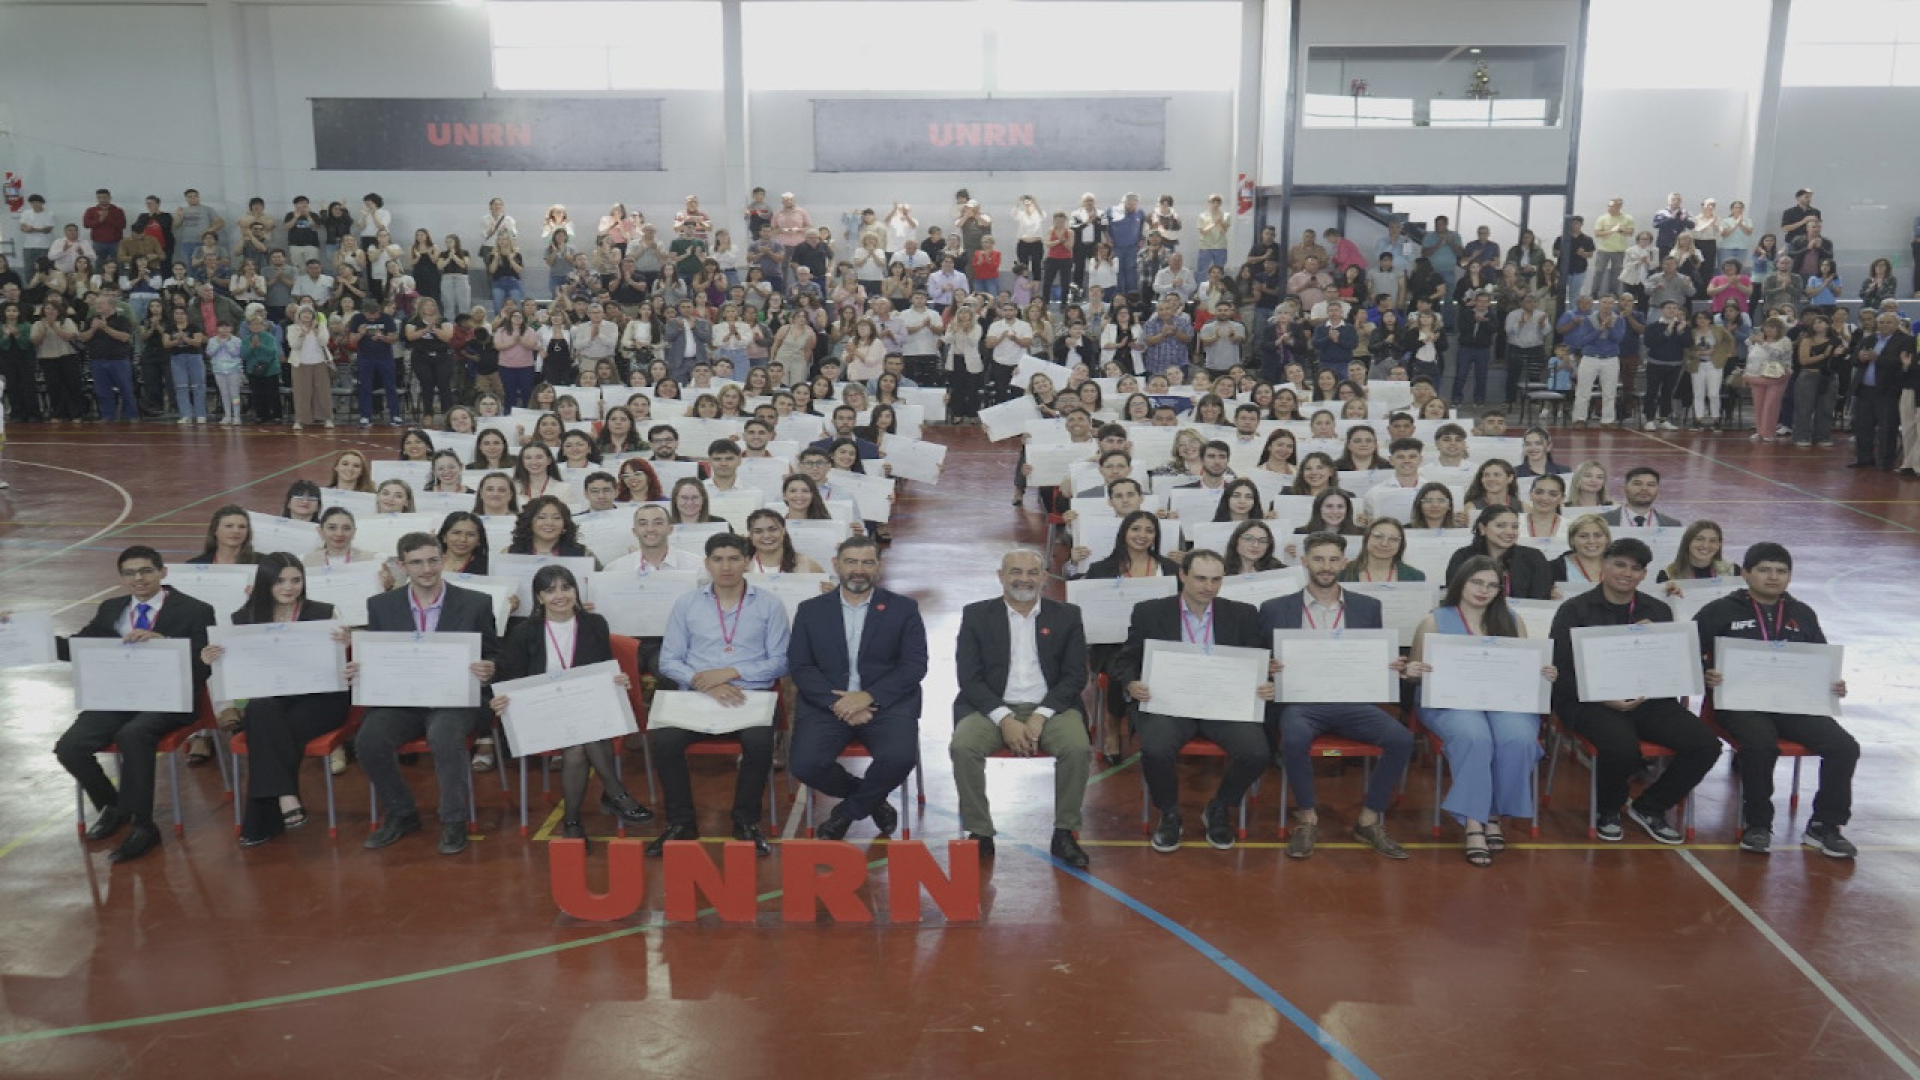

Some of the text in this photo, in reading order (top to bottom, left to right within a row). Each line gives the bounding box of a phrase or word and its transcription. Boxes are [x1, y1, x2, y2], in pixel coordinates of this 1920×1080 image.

[427, 122, 532, 146] UNRN
[928, 122, 1034, 147] UNRN
[1731, 620, 1756, 630] UFC
[549, 839, 980, 922] UNRN
